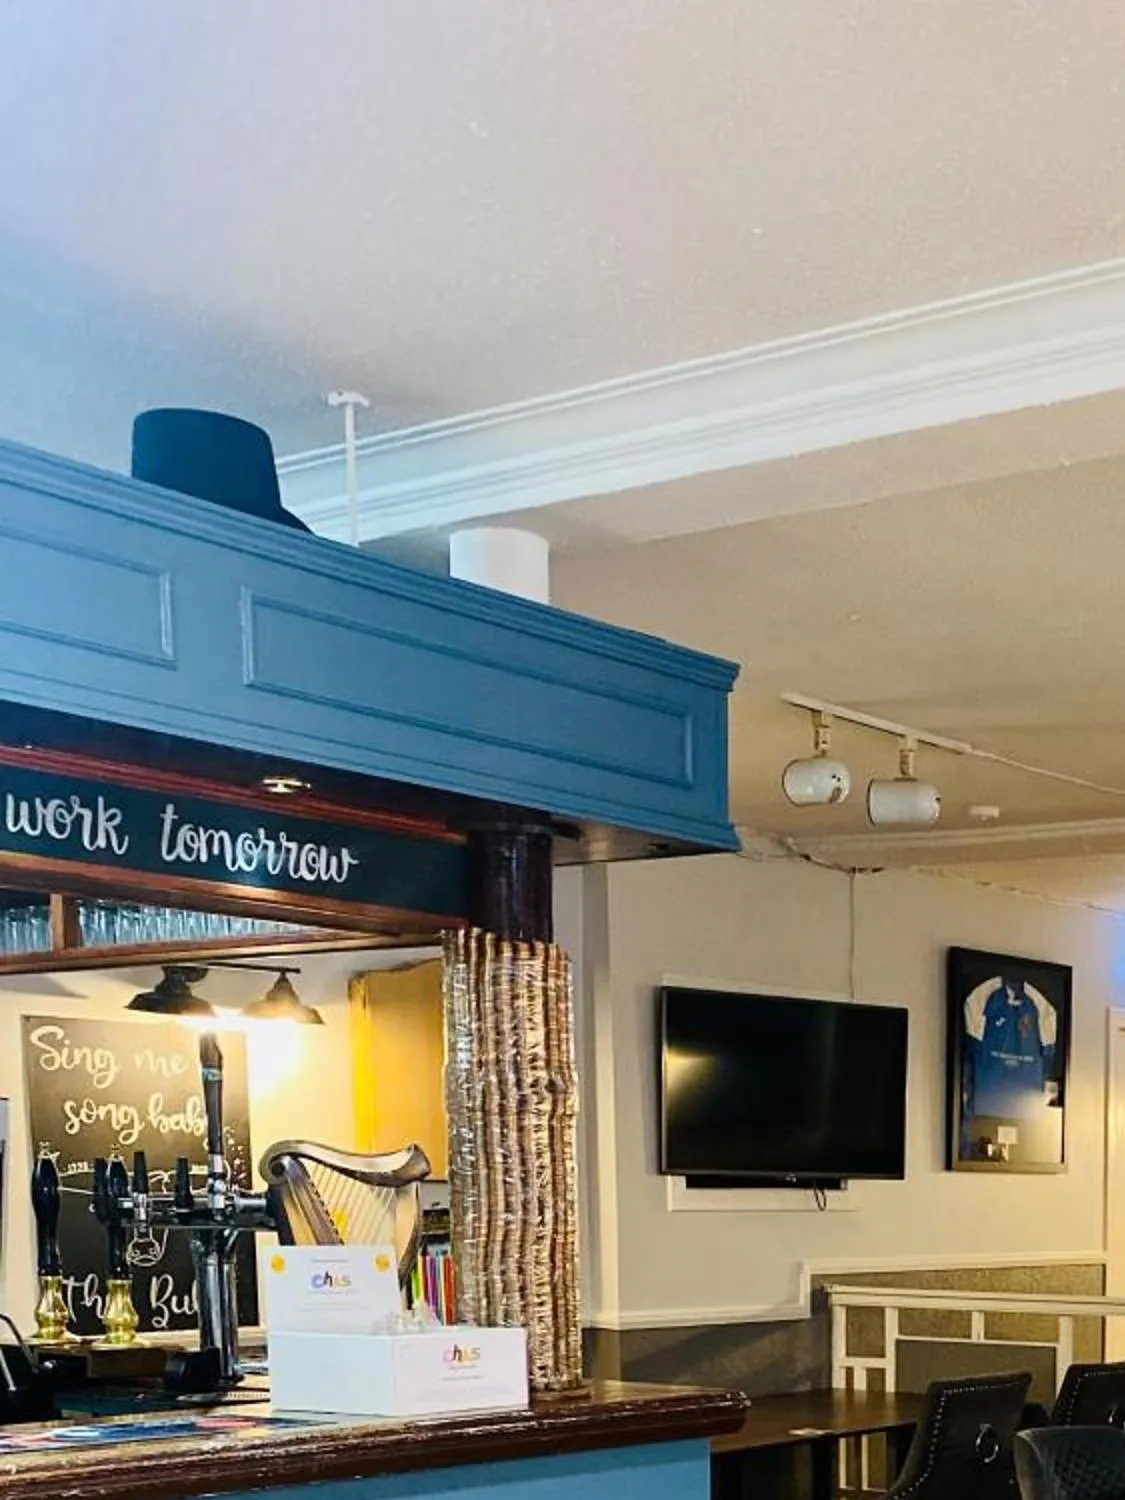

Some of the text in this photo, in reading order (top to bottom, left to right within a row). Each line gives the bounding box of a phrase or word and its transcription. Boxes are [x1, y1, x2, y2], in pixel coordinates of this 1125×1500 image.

[5, 793, 360, 883] work tomorrow
[30, 1025, 189, 1089] Sing me
[64, 1092, 209, 1151] song bab
[62, 1273, 200, 1329] Th Bul
